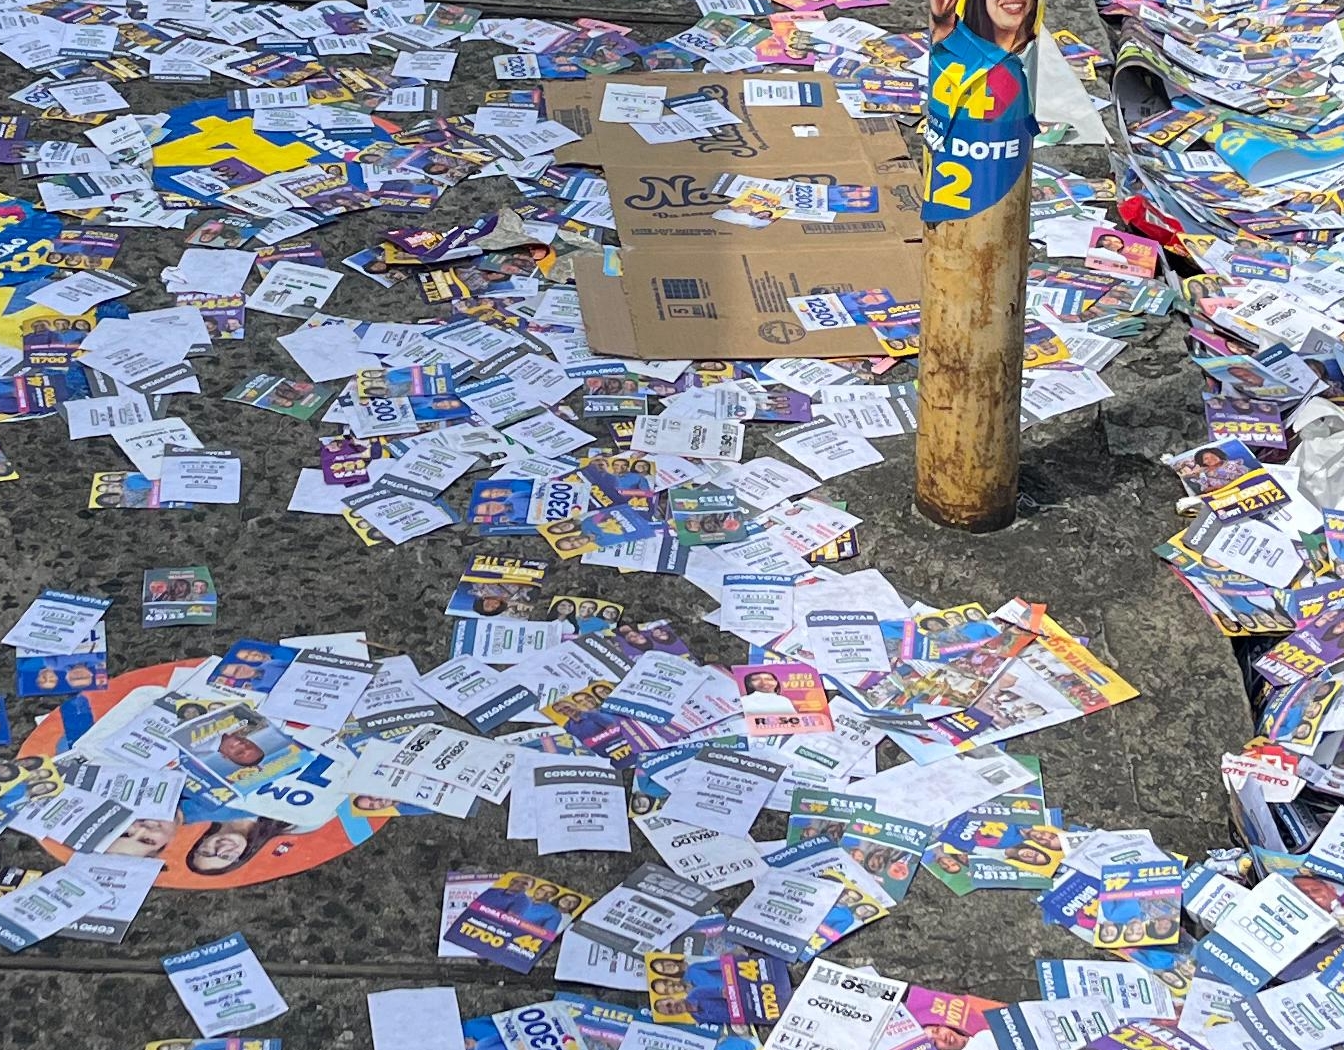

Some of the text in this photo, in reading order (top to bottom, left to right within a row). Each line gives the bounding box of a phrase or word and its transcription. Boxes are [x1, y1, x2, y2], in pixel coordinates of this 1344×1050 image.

[932, 62, 995, 119] 44
[953, 137, 1019, 159] DOTE
[795, 184, 812, 208] 12300
[811, 297, 838, 328] 12300
[809, 614, 839, 622] COMO
[789, 672, 813, 681] SEU
[367, 710, 435, 727] COMO VOTAR
[708, 751, 777, 774] COMO VOTAR
[544, 769, 616, 780] COMO VOTAR
[767, 836, 832, 864] COMO VOTAR
[973, 872, 1017, 880] 45133
[459, 920, 503, 950] 11700
[164, 938, 239, 966] COMO VOTAR
[1205, 940, 1260, 987] COMO VOTAR
